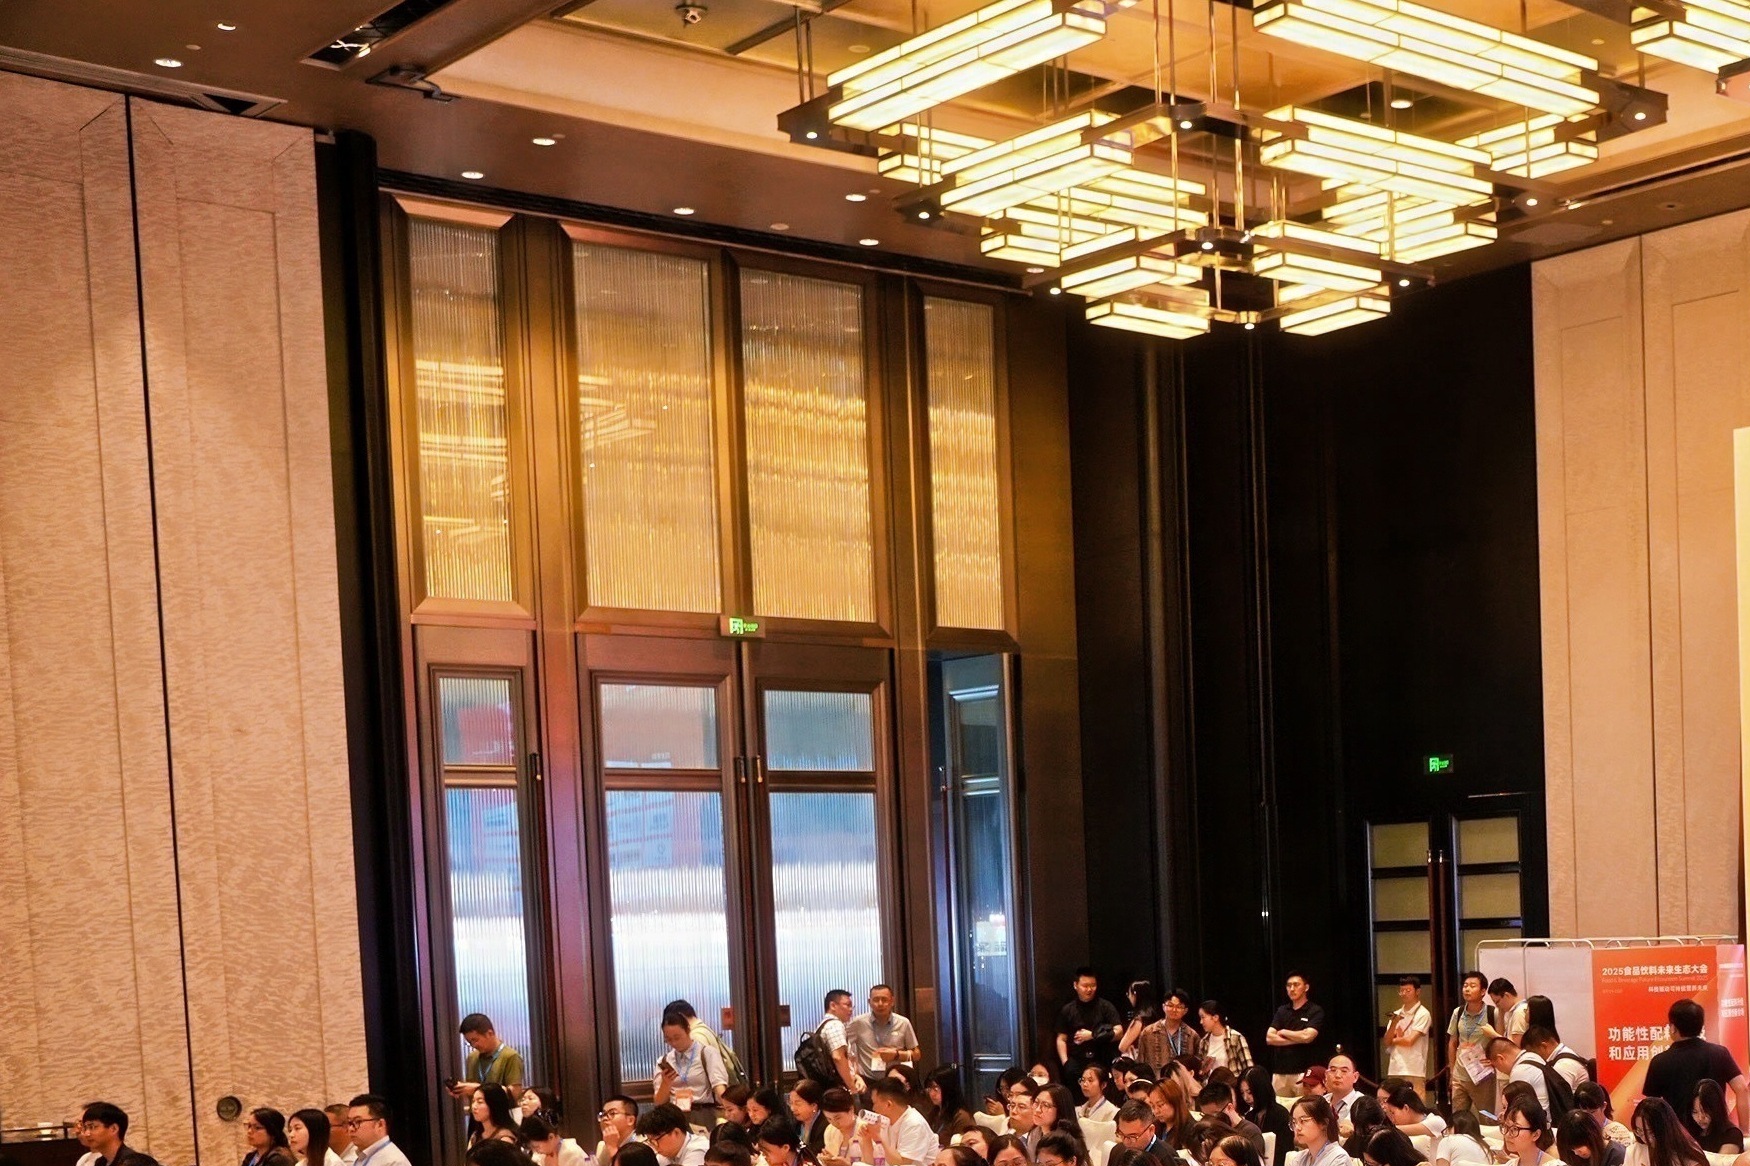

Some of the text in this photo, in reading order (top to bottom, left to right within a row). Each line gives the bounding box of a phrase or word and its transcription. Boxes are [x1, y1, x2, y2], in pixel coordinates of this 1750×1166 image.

[1602, 964, 1708, 976] 2025食品饮料未来生态大会
